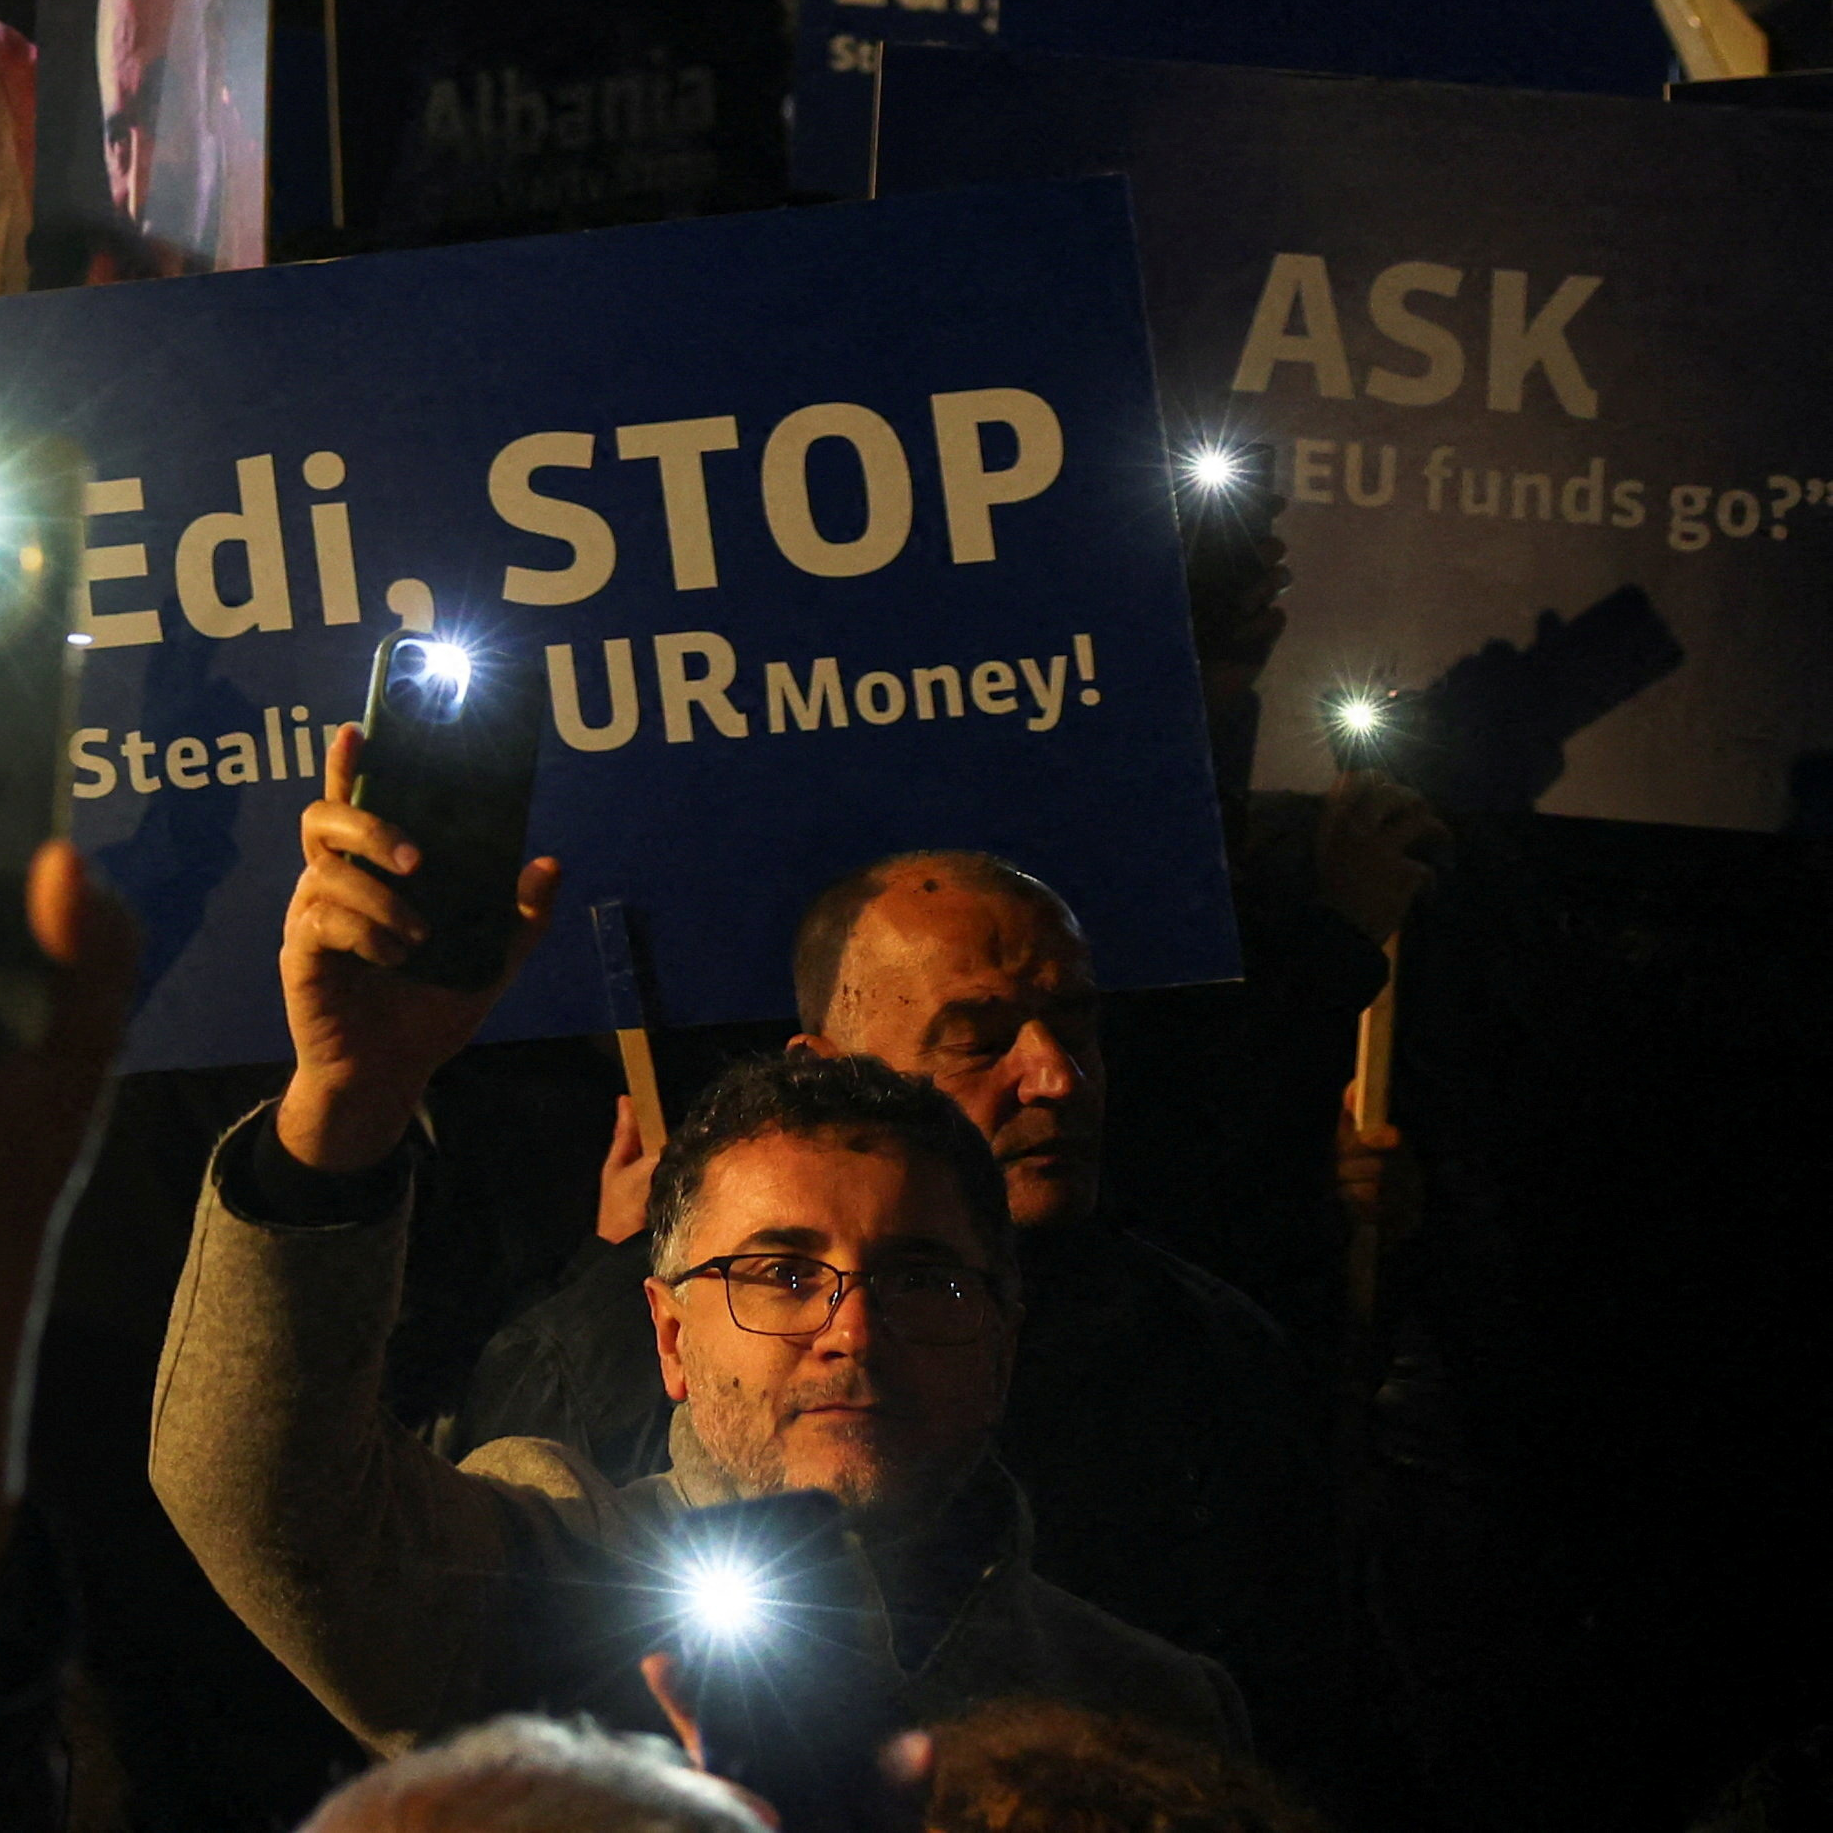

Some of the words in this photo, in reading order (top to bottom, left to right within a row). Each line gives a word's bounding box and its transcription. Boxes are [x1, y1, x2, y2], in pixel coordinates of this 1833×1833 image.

[423, 48, 716, 162] Albania
[1232, 252, 1604, 419] ASK
[81, 451, 434, 650] Edi,
[487, 386, 1064, 606] STOP
[1294, 438, 1397, 508] EU
[1425, 445, 1646, 530] funds
[68, 705, 341, 798] Steali
[544, 630, 749, 752] UR
[765, 632, 1102, 733] Money!
